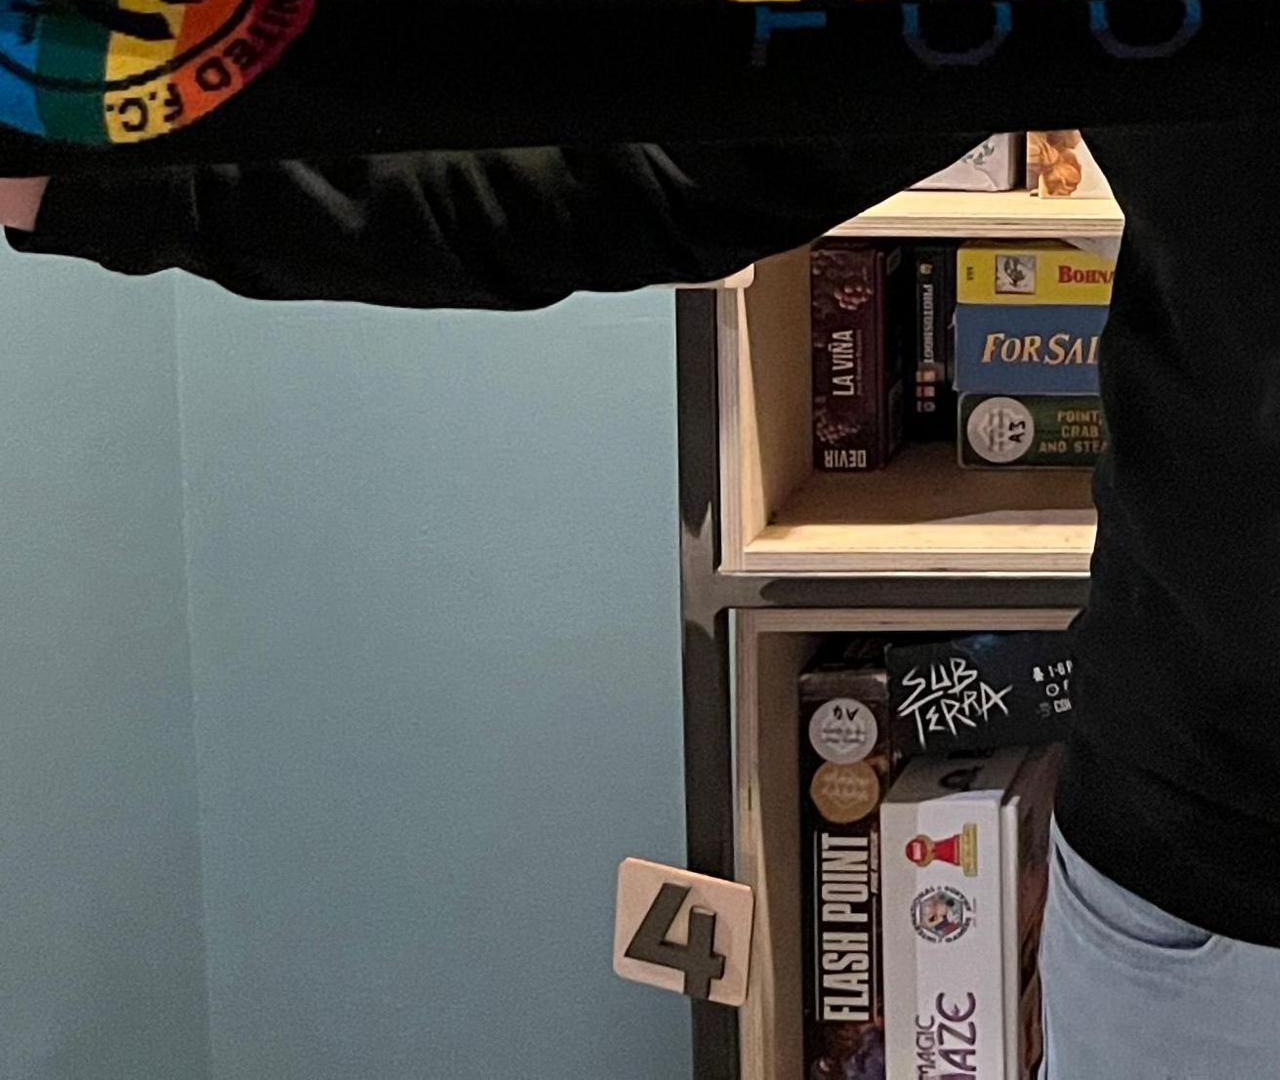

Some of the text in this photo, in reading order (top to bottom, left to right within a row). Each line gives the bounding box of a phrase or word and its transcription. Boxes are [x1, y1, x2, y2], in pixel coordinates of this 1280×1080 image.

[827, 329, 855, 397] LA VIÑA
[981, 332, 1043, 364] FOR
[824, 449, 867, 468] DEVIR
[900, 656, 980, 708] SUB
[896, 684, 1014, 750] TERRA
[624, 882, 726, 1001] 4
[821, 832, 870, 1021] FLASH POINT
[936, 991, 977, 1080] AZE
